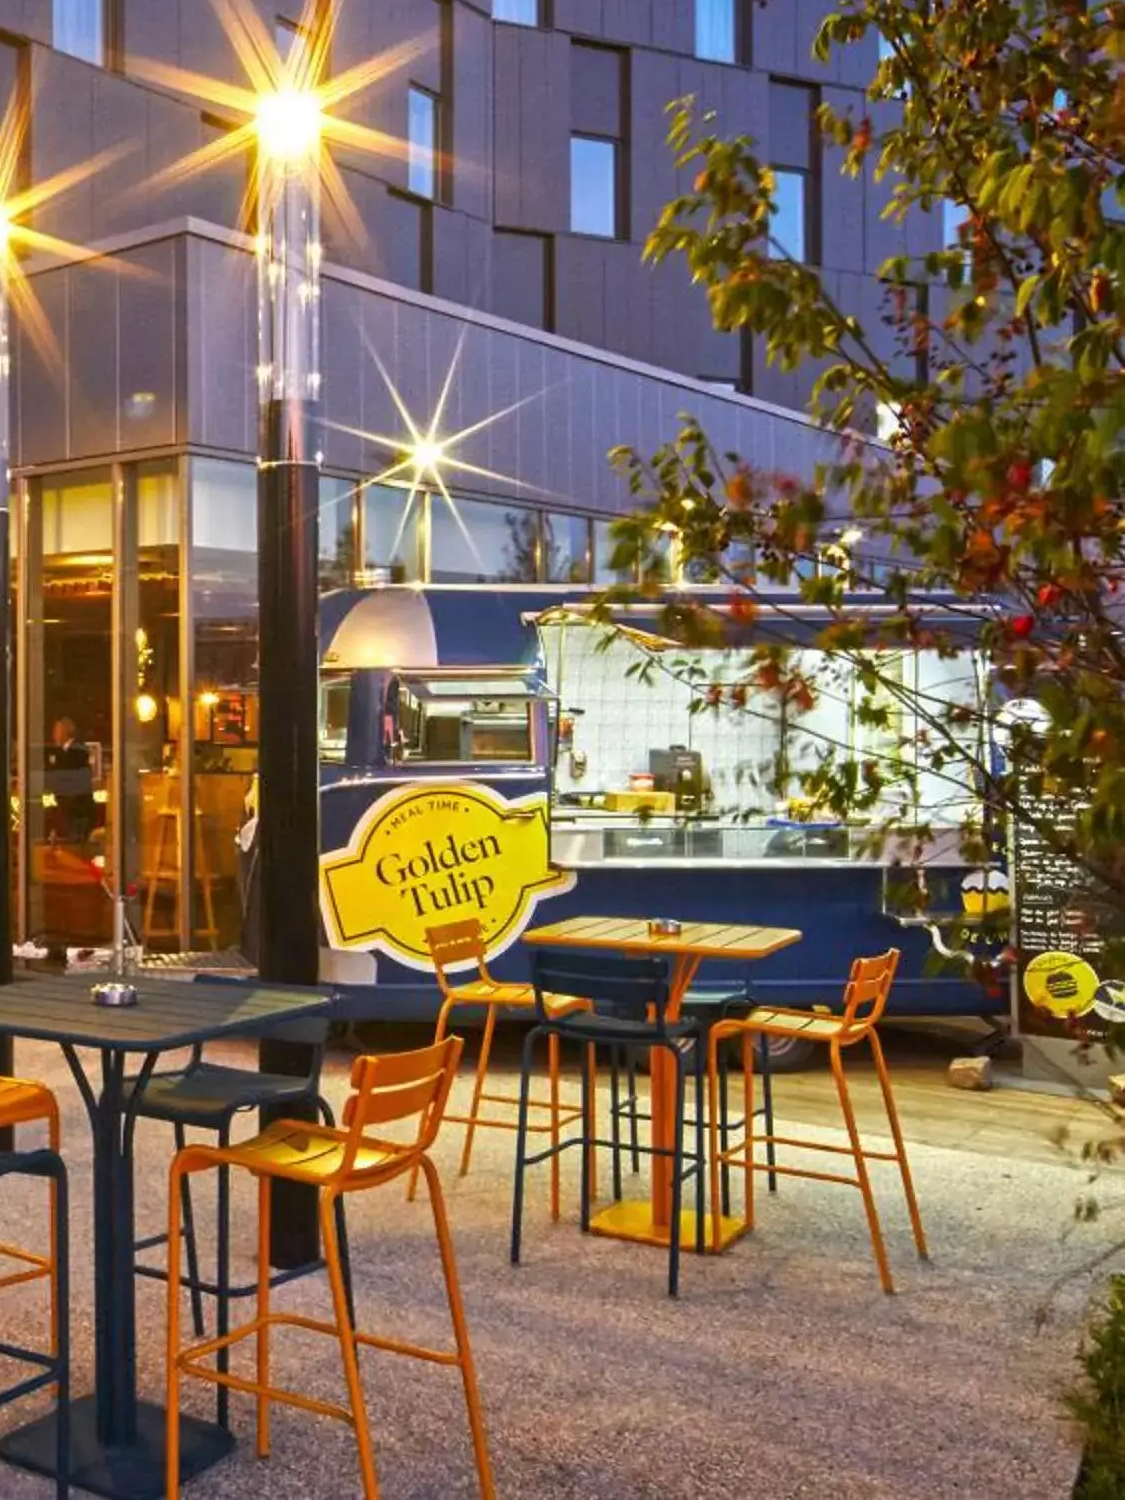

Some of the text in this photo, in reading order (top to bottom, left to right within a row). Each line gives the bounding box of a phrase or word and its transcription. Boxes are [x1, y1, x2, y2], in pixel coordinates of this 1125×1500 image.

[390, 800, 460, 829] MEAL TIME
[376, 834, 502, 888] Golden
[400, 871, 495, 917] Tulip
